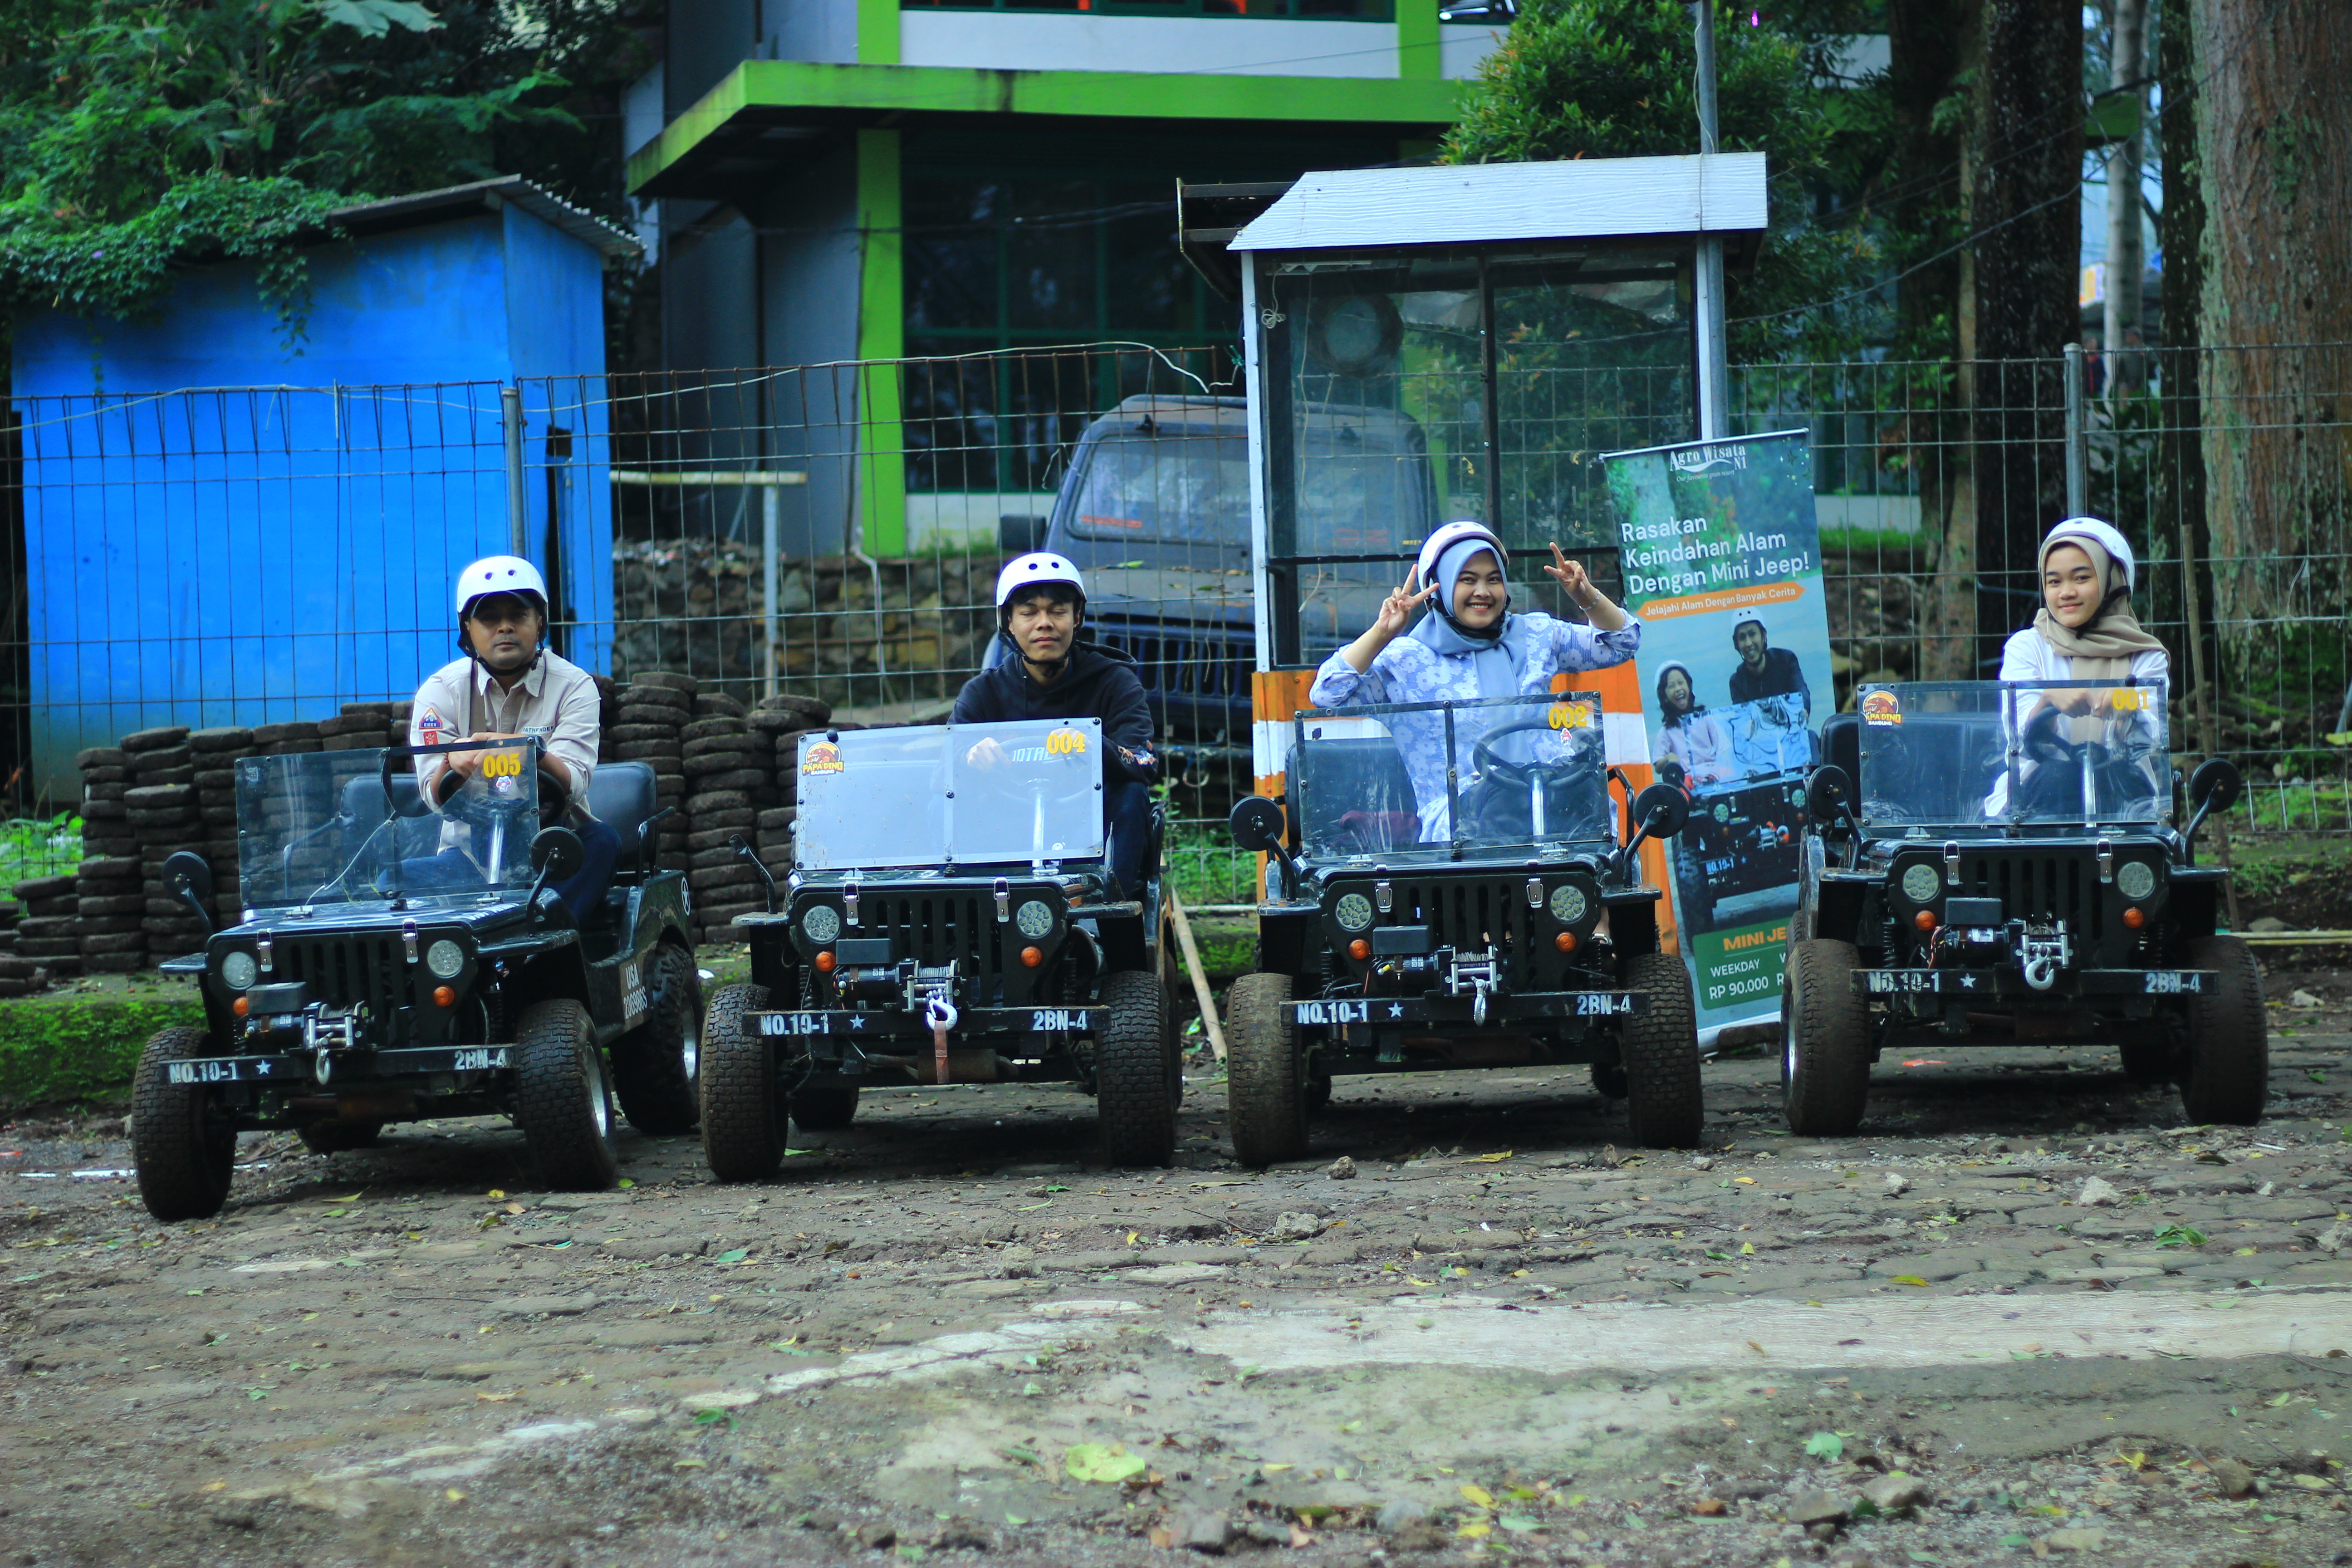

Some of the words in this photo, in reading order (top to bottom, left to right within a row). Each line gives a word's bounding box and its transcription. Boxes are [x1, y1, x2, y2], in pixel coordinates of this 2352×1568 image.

[1670, 451, 1700, 471] Agro
[1702, 443, 1746, 463] Wisata
[1734, 456, 1747, 470] N1
[1621, 516, 1707, 543] Rasakan
[1625, 539, 1731, 569] Keindahan
[1735, 532, 1787, 553] Alam
[1629, 569, 1707, 595] Dengan
[1711, 559, 1749, 583] Mini
[1754, 551, 1811, 578] Jeep!
[1646, 602, 1680, 616] Jelajahi
[1681, 600, 1704, 611] Alam
[1705, 597, 1735, 608] Dengan
[1736, 591, 1767, 603] Banyak
[1769, 587, 1796, 598] Cerita
[2112, 689, 2150, 710] 001
[1548, 705, 1587, 729] 002
[1881, 713, 1901, 724] DINO
[1047, 733, 1085, 754] 004
[483, 753, 521, 778] 005
[803, 764, 822, 774] PAPA
[823, 762, 843, 771] DINO
[1723, 931, 1764, 951] MINI
[1767, 926, 1787, 942] JE
[626, 963, 640, 990] USA
[1710, 958, 1760, 977] WEEKDAY
[1709, 985, 1725, 1000] RP
[1729, 976, 1769, 995] 90.000
[2146, 973, 2200, 993] 2BN-4
[1298, 1001, 1367, 1024] NO.10-1
[1577, 994, 1631, 1015] 2BN-4
[1032, 1010, 1088, 1031] 2BN-4
[169, 1061, 237, 1083] NO.10-1
